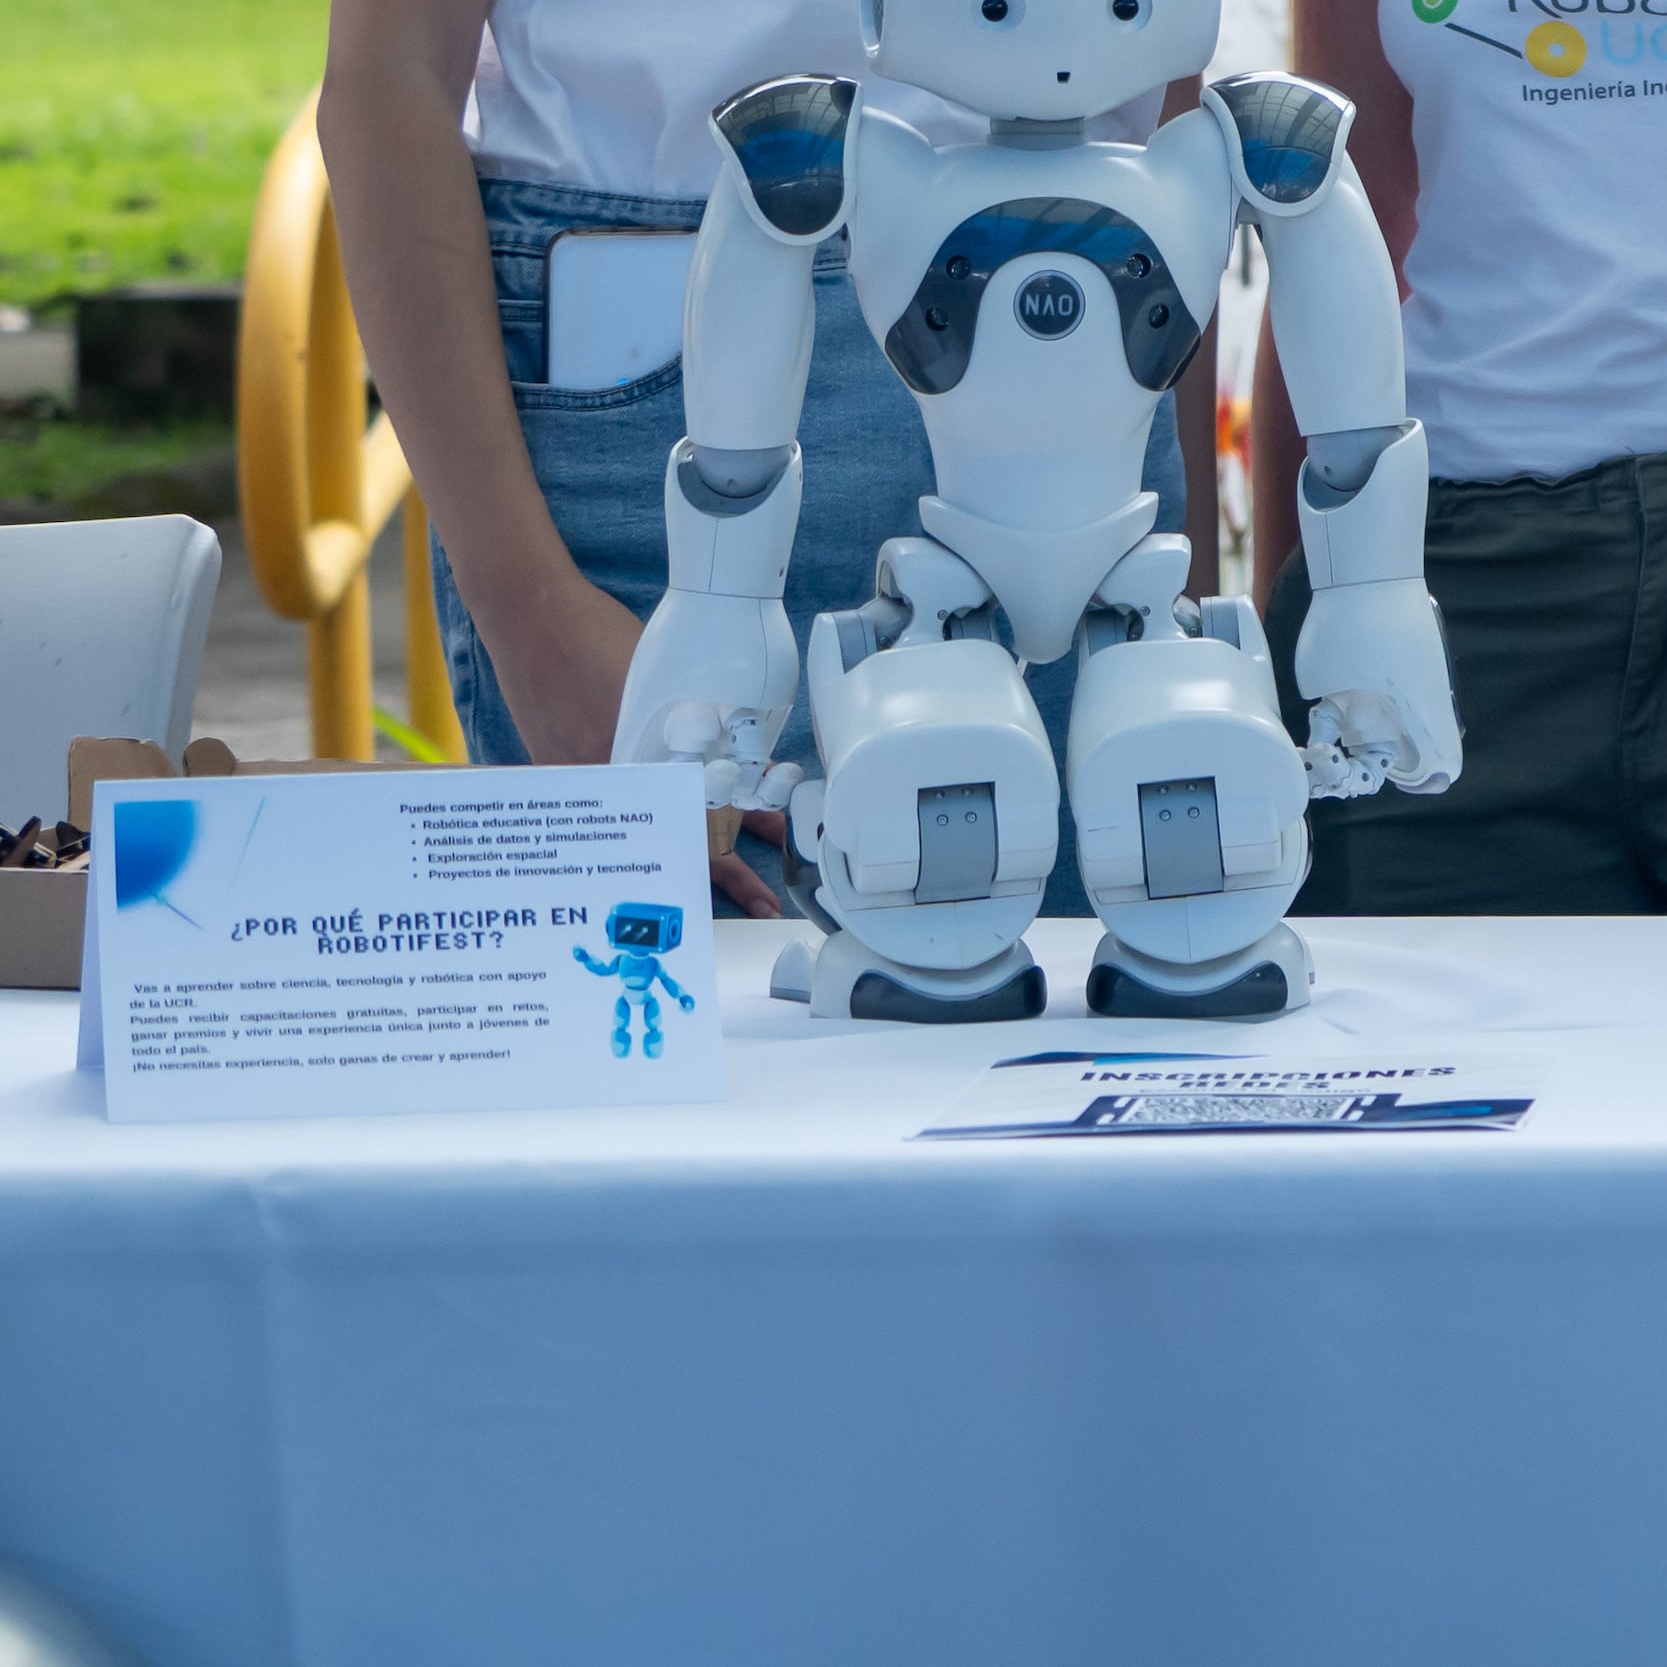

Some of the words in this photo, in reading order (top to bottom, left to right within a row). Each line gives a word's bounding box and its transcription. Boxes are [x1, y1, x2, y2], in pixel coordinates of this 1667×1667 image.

[1522, 79, 1636, 107] Ingeniería
[1025, 294, 1073, 316] NAO
[400, 804, 446, 815] Puedes
[450, 802, 505, 814] competir
[508, 802, 524, 810] en
[527, 800, 561, 810] áreas
[564, 799, 604, 809] como:
[422, 819, 479, 830] Robótica
[482, 817, 542, 828] educativa
[545, 816, 573, 828] (con
[576, 814, 617, 824] robots
[620, 813, 653, 825] NAO)
[424, 836, 474, 847] Análisis
[477, 835, 493, 845] de
[496, 834, 531, 844] datos
[534, 835, 542, 845] y
[545, 832, 628, 842] simulaciones
[428, 851, 503, 864] Exploración
[506, 849, 558, 861] espacial
[429, 869, 492, 881] Proyectos
[495, 867, 511, 877] de
[514, 865, 583, 876] innovación
[586, 865, 594, 876] y
[597, 862, 663, 875] tecnología
[231, 918, 298, 942] ¿POR
[311, 908, 364, 936] QUÉ
[378, 909, 537, 932] PARTICIPAR
[551, 907, 588, 926] EN
[317, 931, 504, 955] ROBOTIFEST?
[134, 984, 158, 994] Vas
[163, 985, 171, 993] a
[176, 982, 235, 994] aprender
[240, 980, 277, 990] sobre
[282, 978, 331, 989] ciencia,
[336, 975, 404, 987] tecnología
[409, 977, 416, 986] y
[421, 973, 474, 984] robótica
[479, 973, 503, 982] con
[507, 971, 547, 982] apoyo
[129, 999, 145, 1009] de
[149, 999, 160, 1008] la
[164, 998, 197, 1008] UCR.
[130, 1014, 179, 1025] Puedes
[189, 1013, 230, 1023] recibir
[240, 1010, 337, 1023] capacitaciones
[347, 1006, 408, 1019] gratuitas,
[417, 1005, 478, 1016] participar
[487, 1004, 503, 1013] en
[513, 1002, 549, 1012] retos,
[131, 1031, 168, 1042] ganar
[174, 1028, 227, 1040] premios
[232, 1029, 240, 1040] y
[245, 1027, 273, 1037] vivir
[278, 1027, 303, 1036] una
[308, 1023, 382, 1035] experiencia
[428, 1019, 461, 1033] junto
[467, 1021, 474, 1029] a
[480, 1017, 529, 1030] jóvenes
[535, 1017, 550, 1027] de
[132, 1046, 161, 1056] todo
[165, 1045, 177, 1055] el
[180, 1045, 211, 1056] país.
[159, 1059, 221, 1070] necesitas
[225, 1056, 304, 1070] experiencia,
[308, 1055, 336, 1065] solo
[339, 1054, 378, 1066] ganas
[382, 1052, 398, 1063] de
[402, 1051, 434, 1062] crear
[438, 1052, 445, 1063] y
[449, 1048, 511, 1061] aprender!
[1080, 1066, 1457, 1082] INSCRIPCIONES
